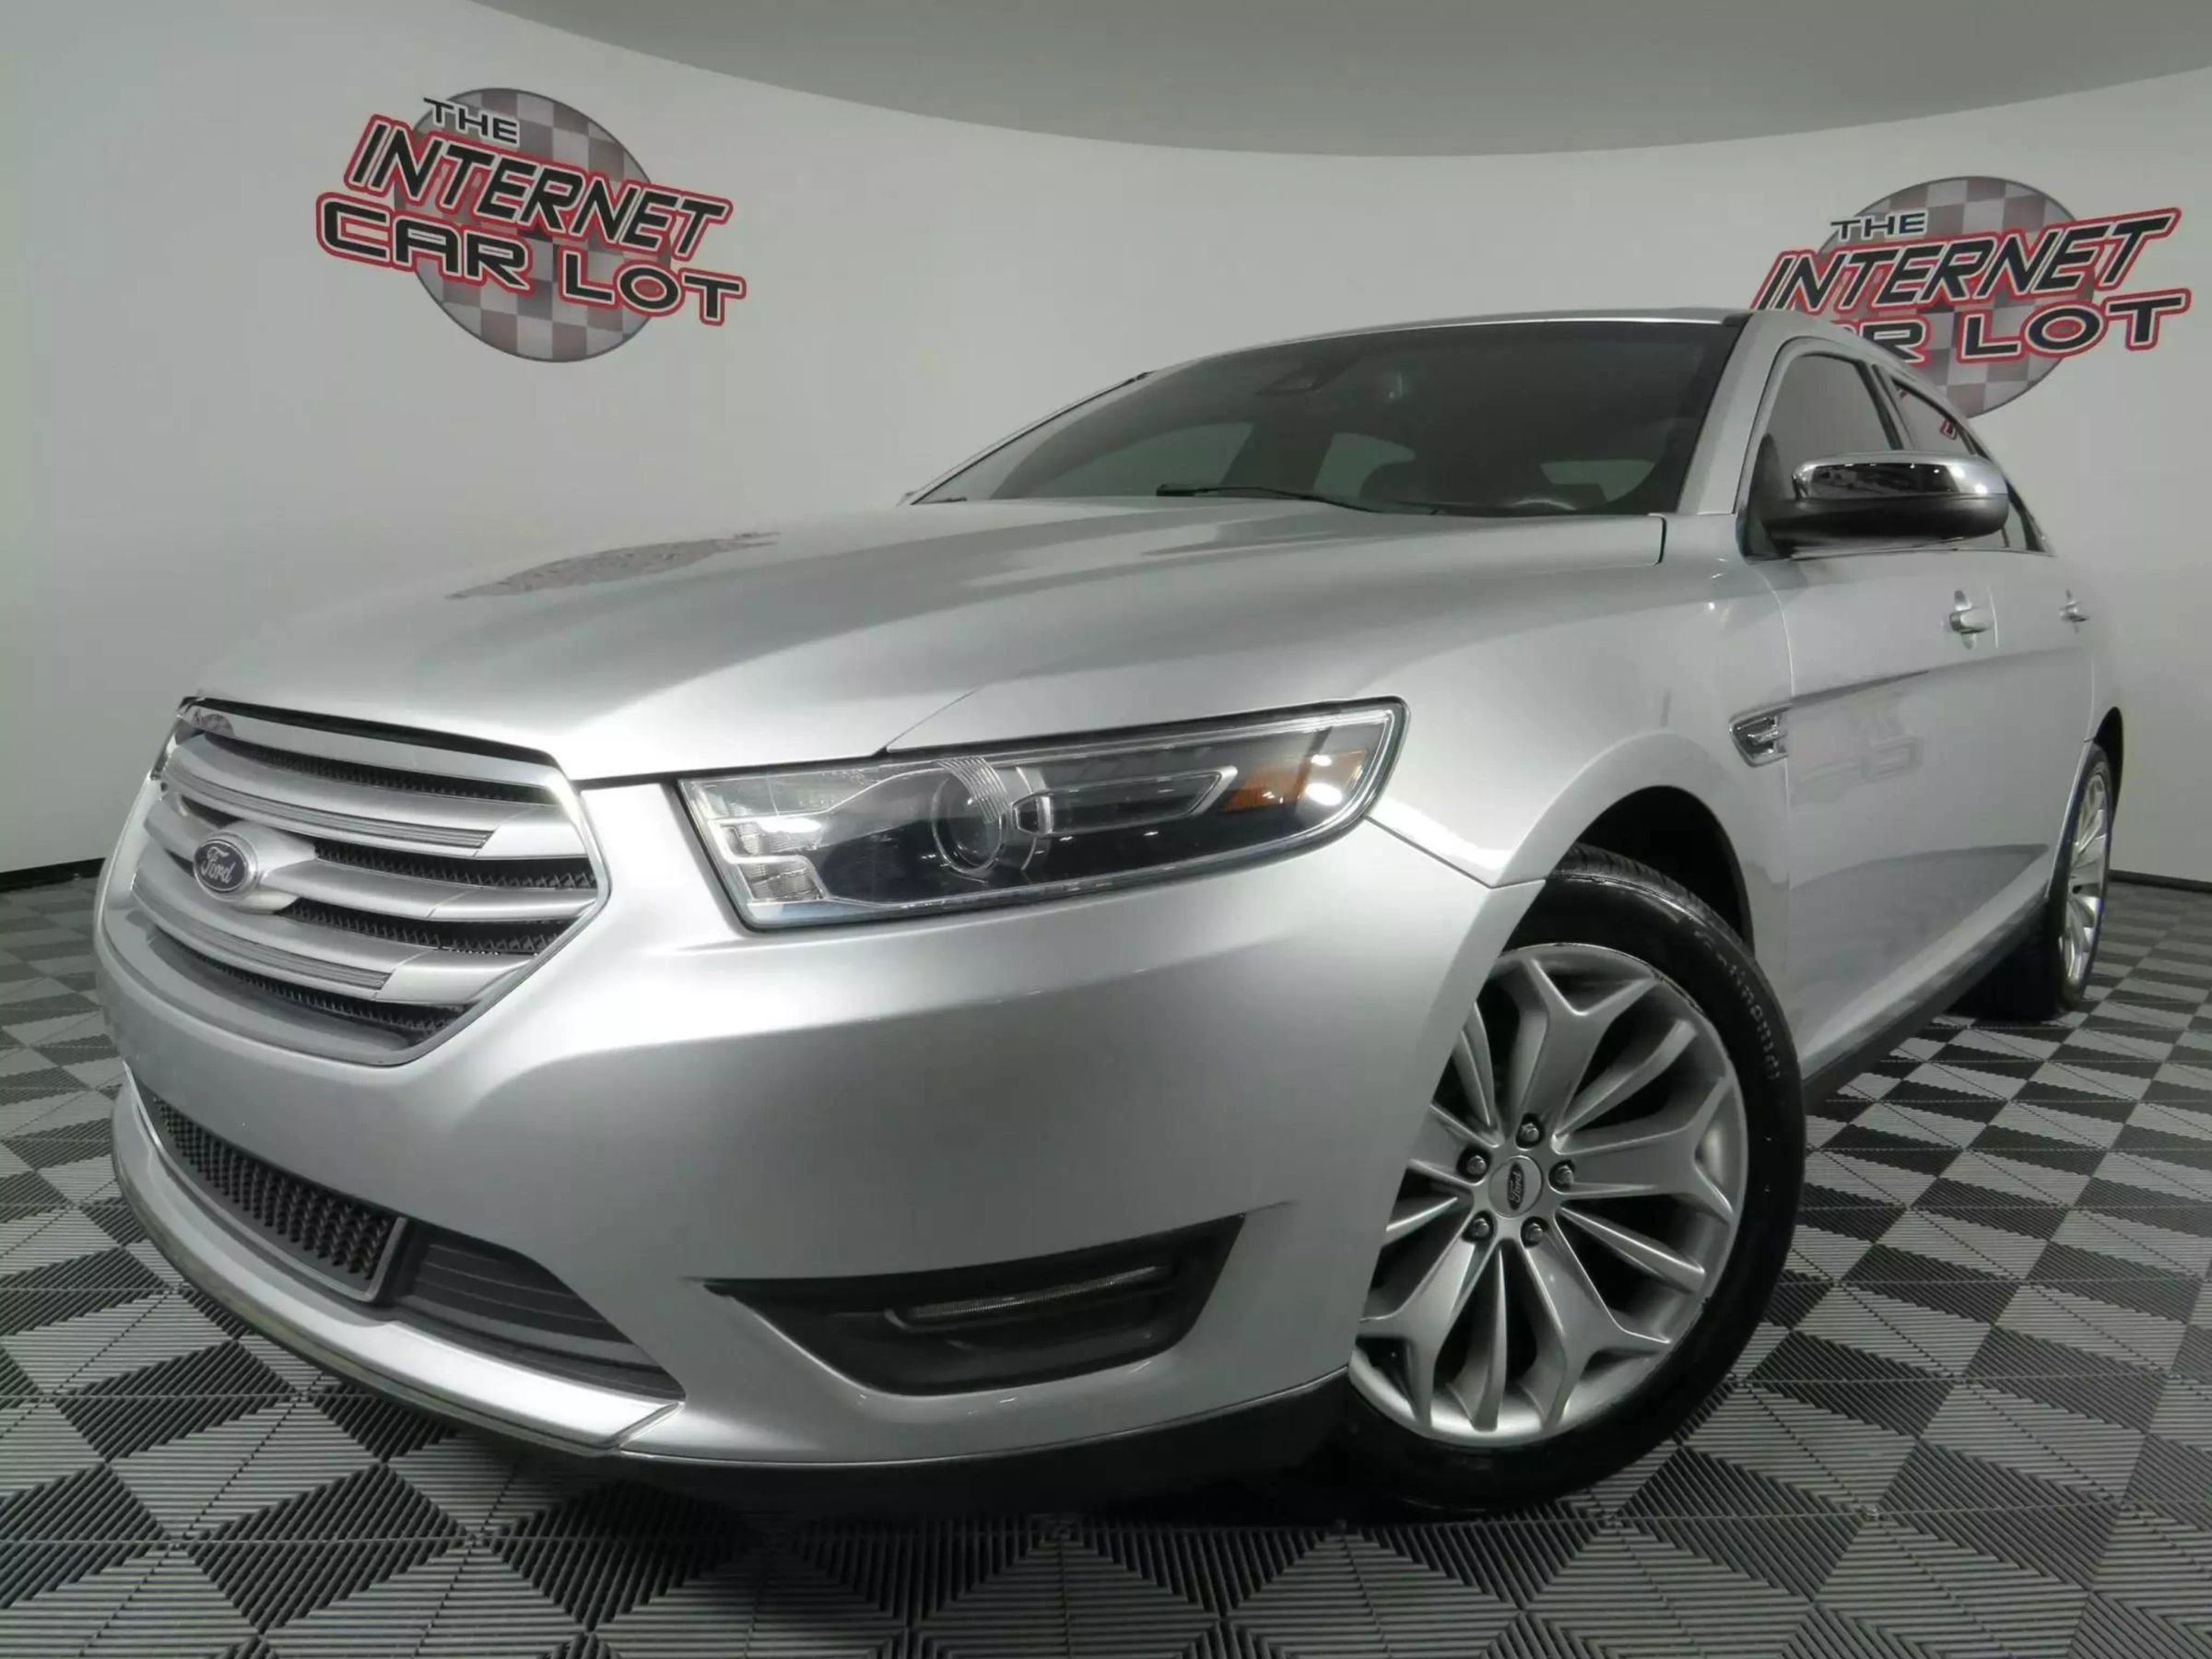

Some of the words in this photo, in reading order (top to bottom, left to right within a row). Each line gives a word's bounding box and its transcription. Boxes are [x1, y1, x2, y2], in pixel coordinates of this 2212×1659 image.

[422, 96, 519, 146] THE
[348, 119, 730, 257] INTERNET
[1829, 211, 1929, 241] THE
[320, 196, 531, 293] CAR
[561, 250, 743, 323] LOT
[1754, 211, 2176, 312] INTERNET
[1961, 293, 2186, 359] LOT
[201, 846, 236, 884] Ford
[1510, 1170, 1523, 1203] Ford
